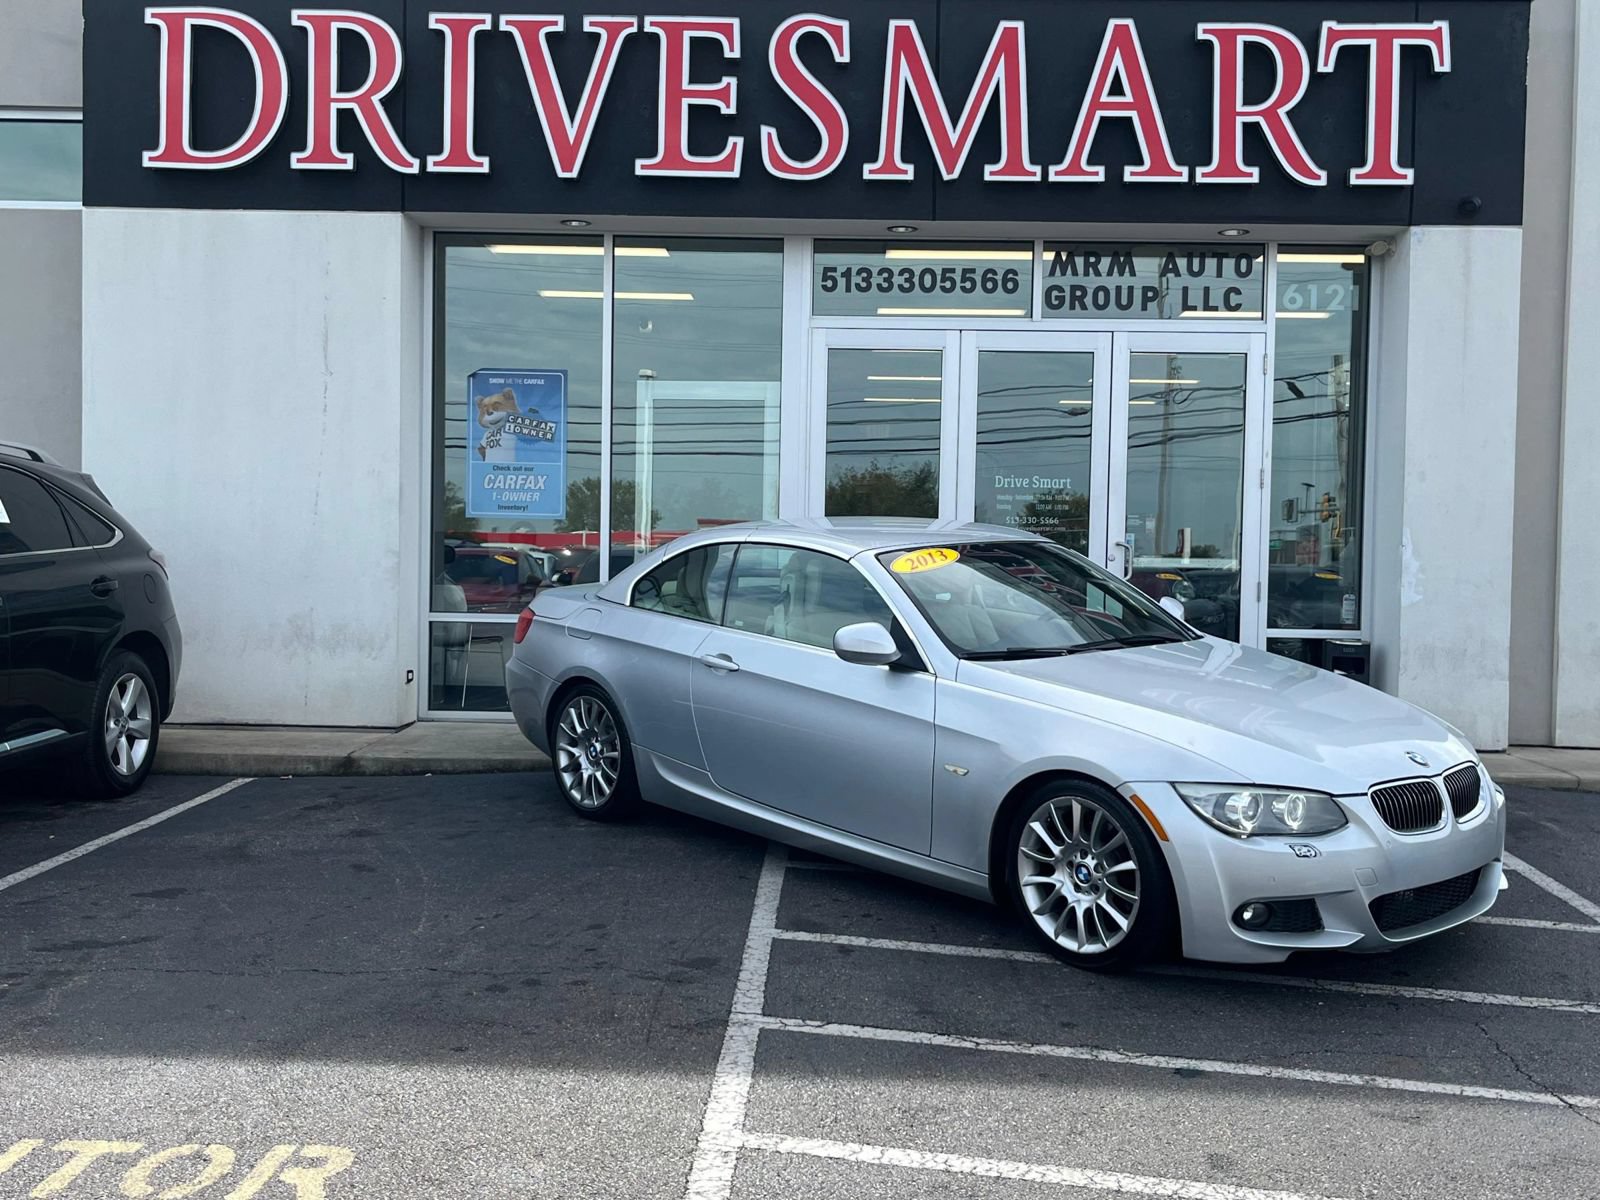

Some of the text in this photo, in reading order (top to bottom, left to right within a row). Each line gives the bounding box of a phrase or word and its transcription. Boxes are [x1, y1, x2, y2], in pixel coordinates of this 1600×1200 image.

[142, 6, 1452, 187] DRIVESMART
[1048, 251, 1253, 278] MRM AUTO
[820, 266, 1020, 294] 5133305566
[1044, 284, 1243, 312] GROUP LLC
[1282, 283, 1359, 311] 6121
[508, 415, 556, 433] CARFAX
[514, 426, 553, 440] OWNER
[484, 474, 548, 490] CARFAX
[995, 474, 1072, 488] Drive Smart
[497, 504, 529, 512] Inventory!
[1005, 516, 1060, 525] 513-330-5566
[904, 549, 949, 571] 2013
